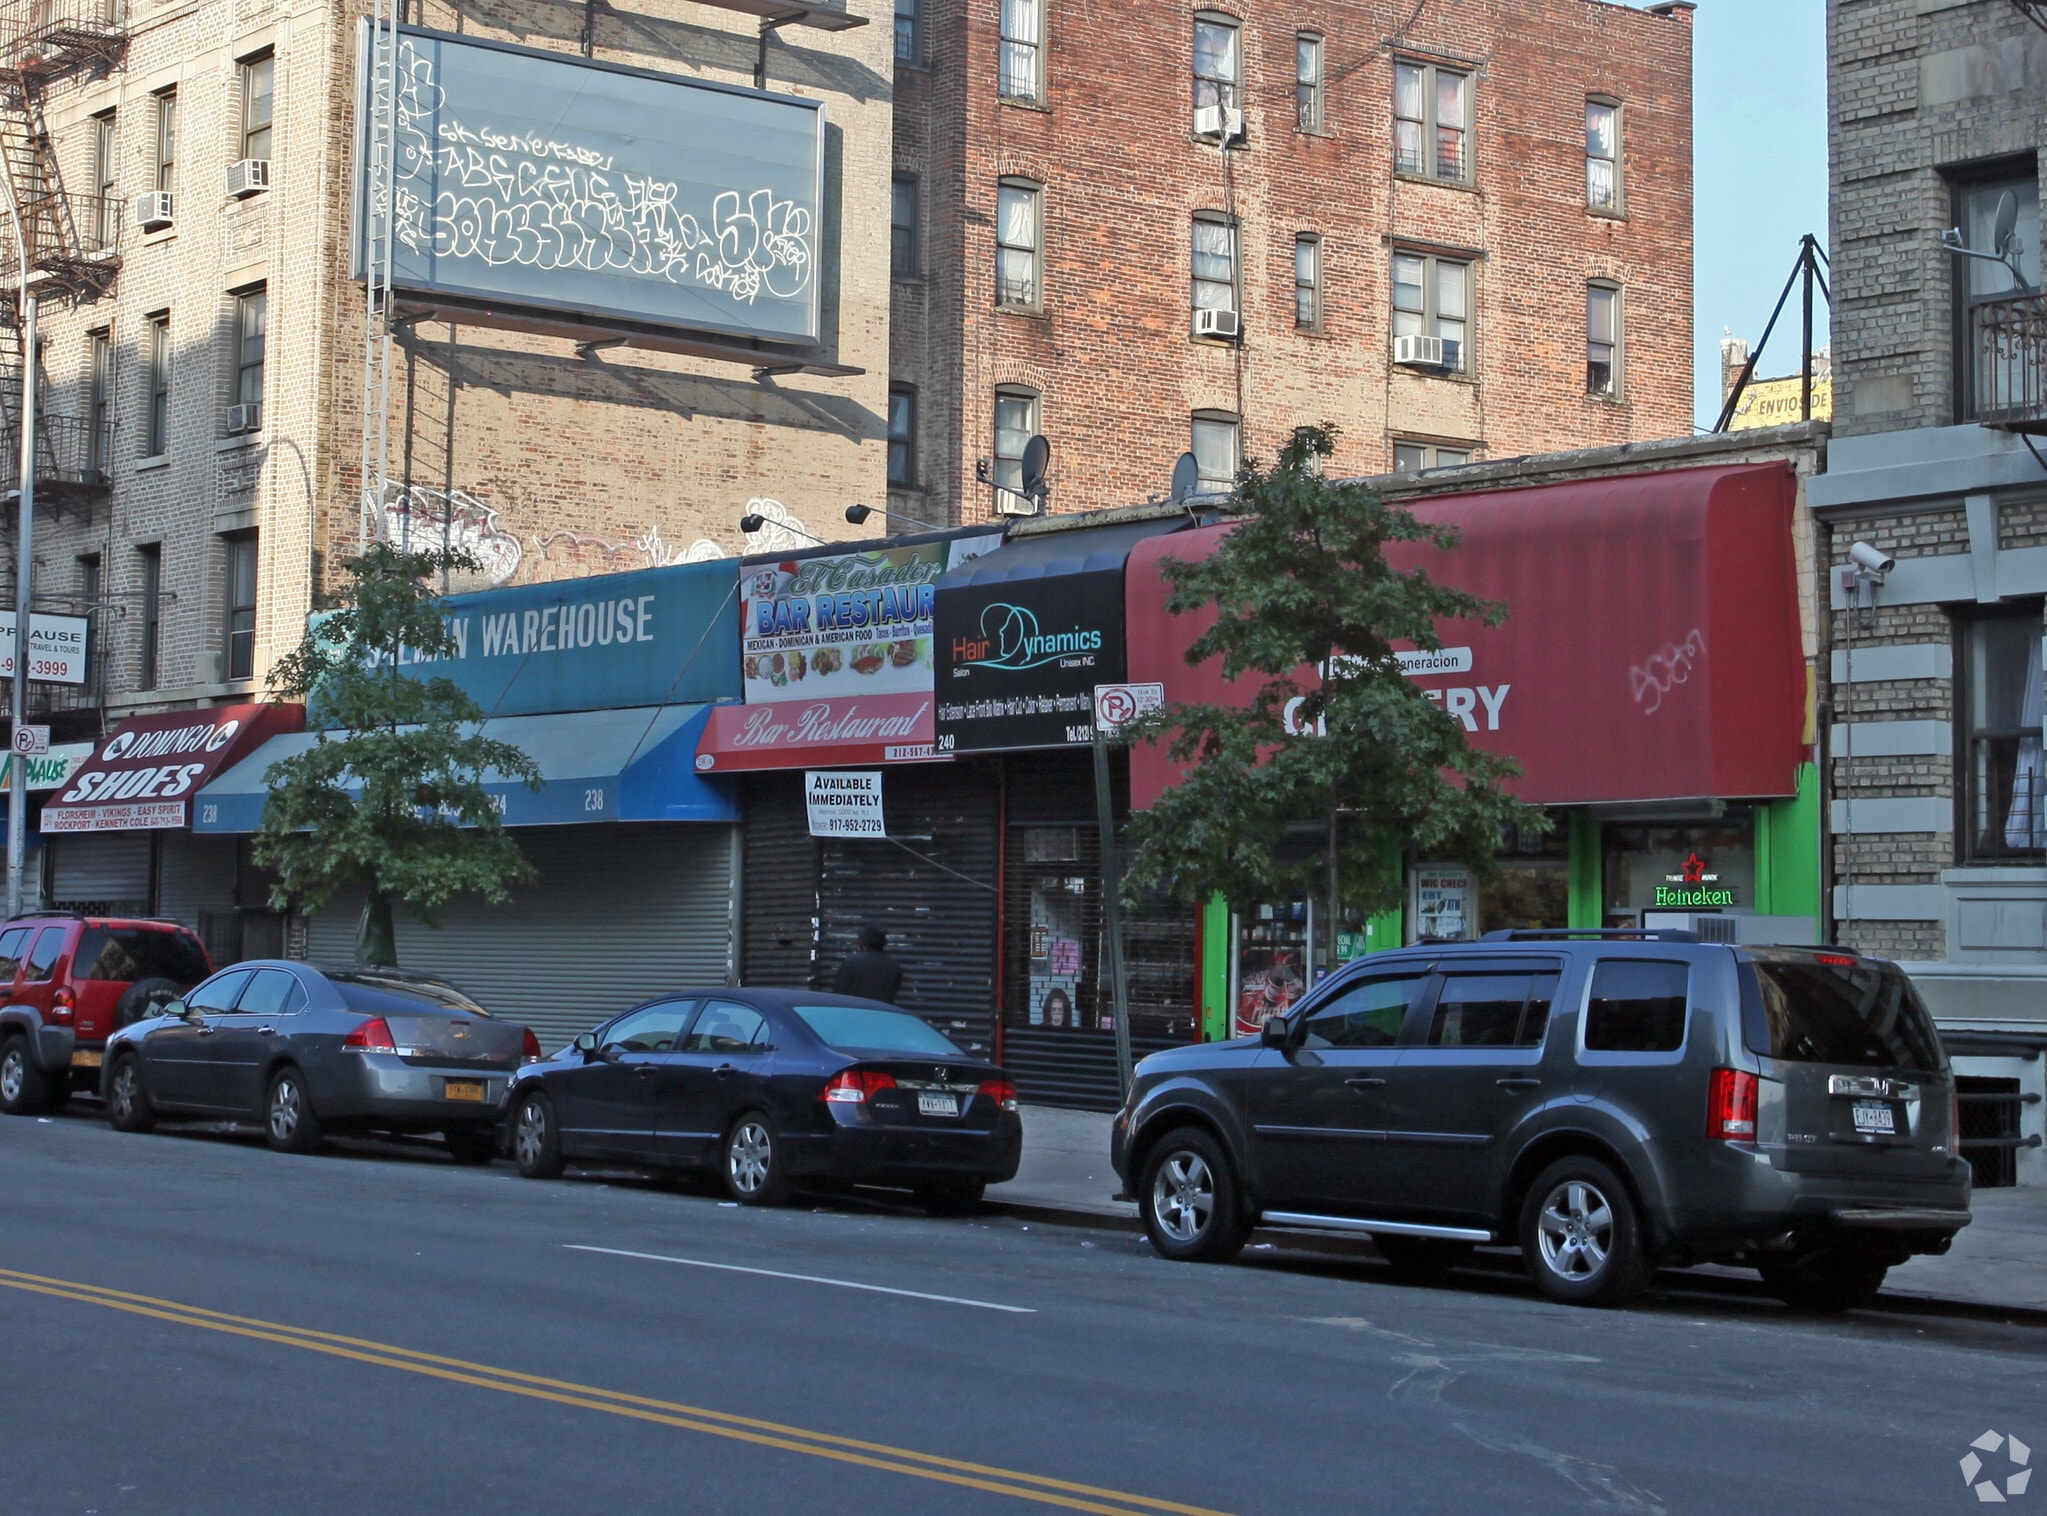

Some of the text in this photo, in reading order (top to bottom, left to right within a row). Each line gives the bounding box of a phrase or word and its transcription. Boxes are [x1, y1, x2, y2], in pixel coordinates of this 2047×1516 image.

[1811, 393, 1828, 409] DE
[757, 584, 935, 636] BAR RESTAUR
[482, 595, 655, 656] WAREHOUSE
[747, 638, 775, 650] MEXICAN
[778, 635, 814, 649] DOMINICAN
[821, 631, 854, 647] AMERICAN
[855, 629, 873, 641] FOOD
[29, 642, 52, 652] TRAVEL
[60, 645, 80, 654] TOURS
[952, 635, 990, 661] Hair
[1060, 658, 1081, 668] Unisex
[1397, 655, 1459, 670] eneracion
[953, 668, 970, 678] Salon
[733, 701, 930, 746] Bar Restaurant
[122, 724, 215, 759] DOMINGO
[938, 734, 955, 750] 240
[62, 763, 205, 802] SHOES
[814, 776, 872, 790] AVAILABLE
[585, 789, 604, 811] 238
[809, 792, 880, 806] IMMEDIATELY
[57, 804, 181, 820] FLORSHEIM VIKINGS EASY SPIRIT
[203, 804, 218, 824] 238
[54, 819, 91, 830] ROCKPORT
[95, 817, 128, 828] KENNETH
[130, 816, 148, 827] COLE
[829, 819, 882, 832] 917-952-2729
[1655, 886, 1733, 906] Heineken
